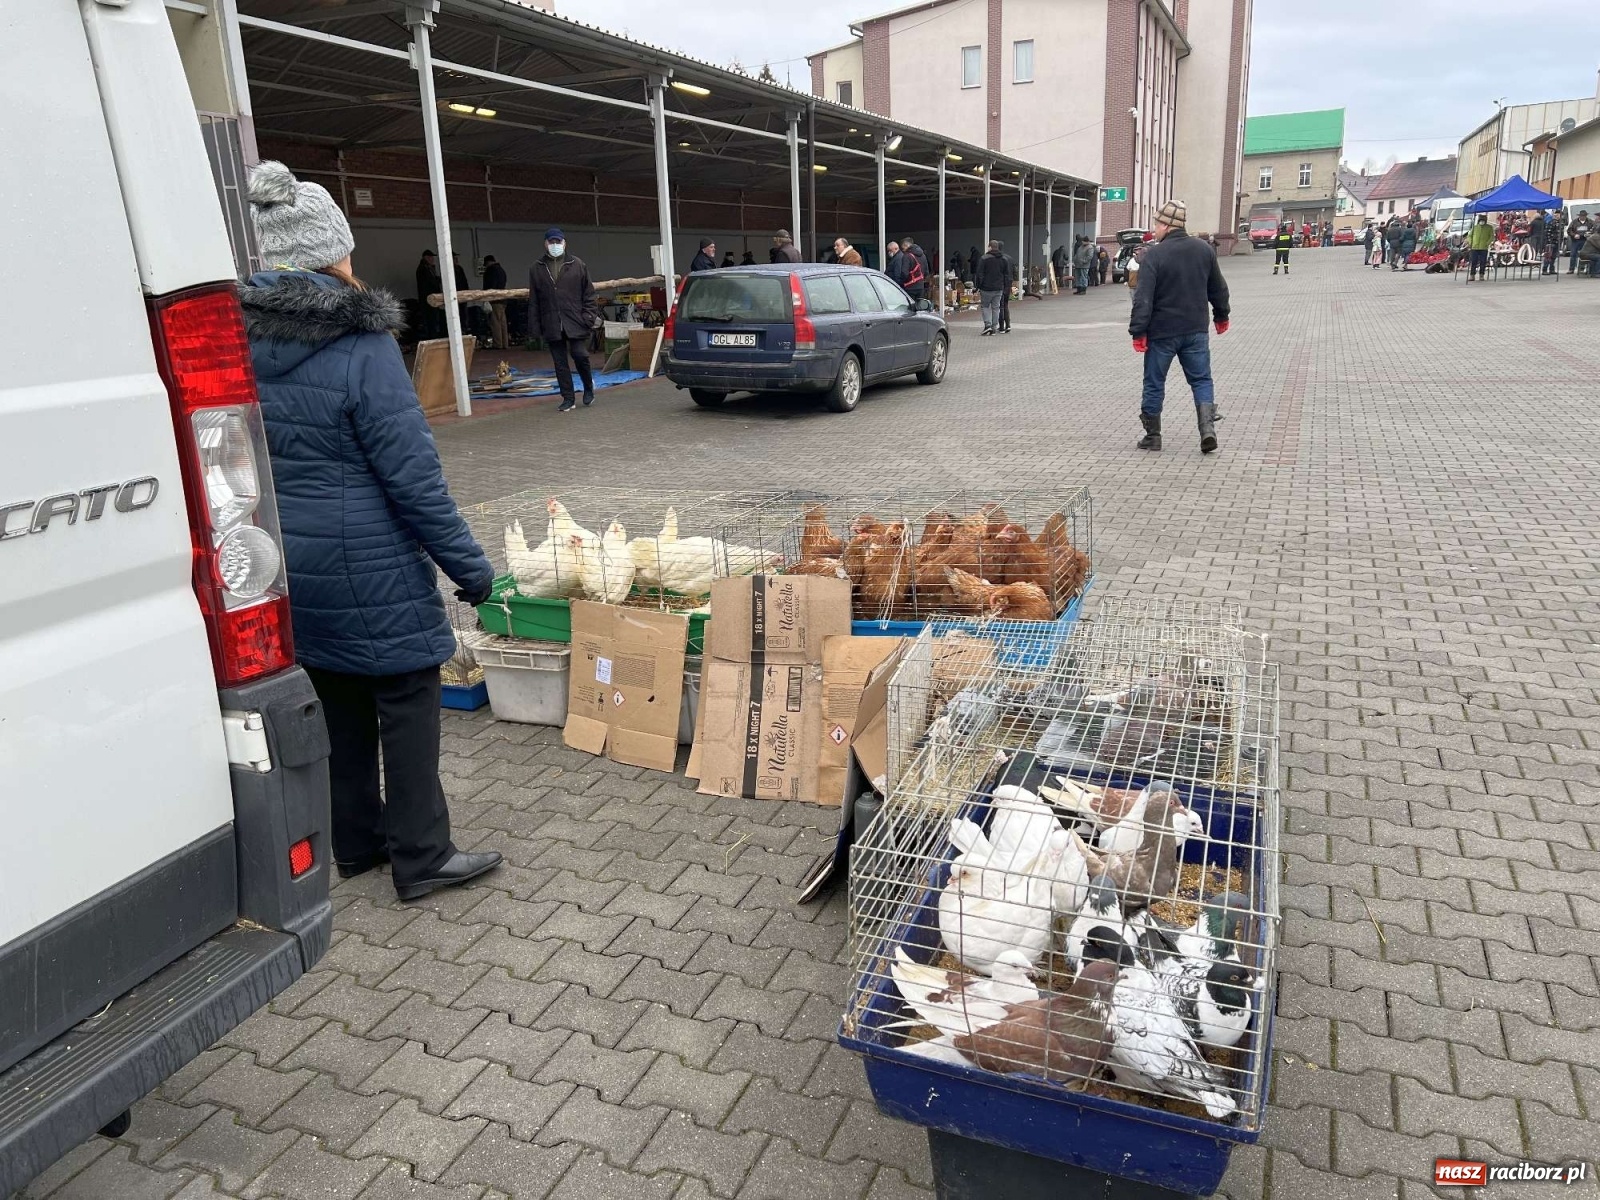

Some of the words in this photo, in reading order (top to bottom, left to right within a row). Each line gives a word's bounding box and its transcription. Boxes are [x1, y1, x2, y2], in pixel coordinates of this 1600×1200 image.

[713, 335, 731, 345] OGL
[733, 335, 754, 345] AL85
[779, 583, 793, 634] Naturella
[755, 623, 763, 634] 18
[750, 701, 761, 709] 7
[750, 710, 760, 737] NIGHT
[746, 745, 757, 759] 18
[768, 714, 788, 775] Naturella
[788, 728, 796, 758] CLASSIC
